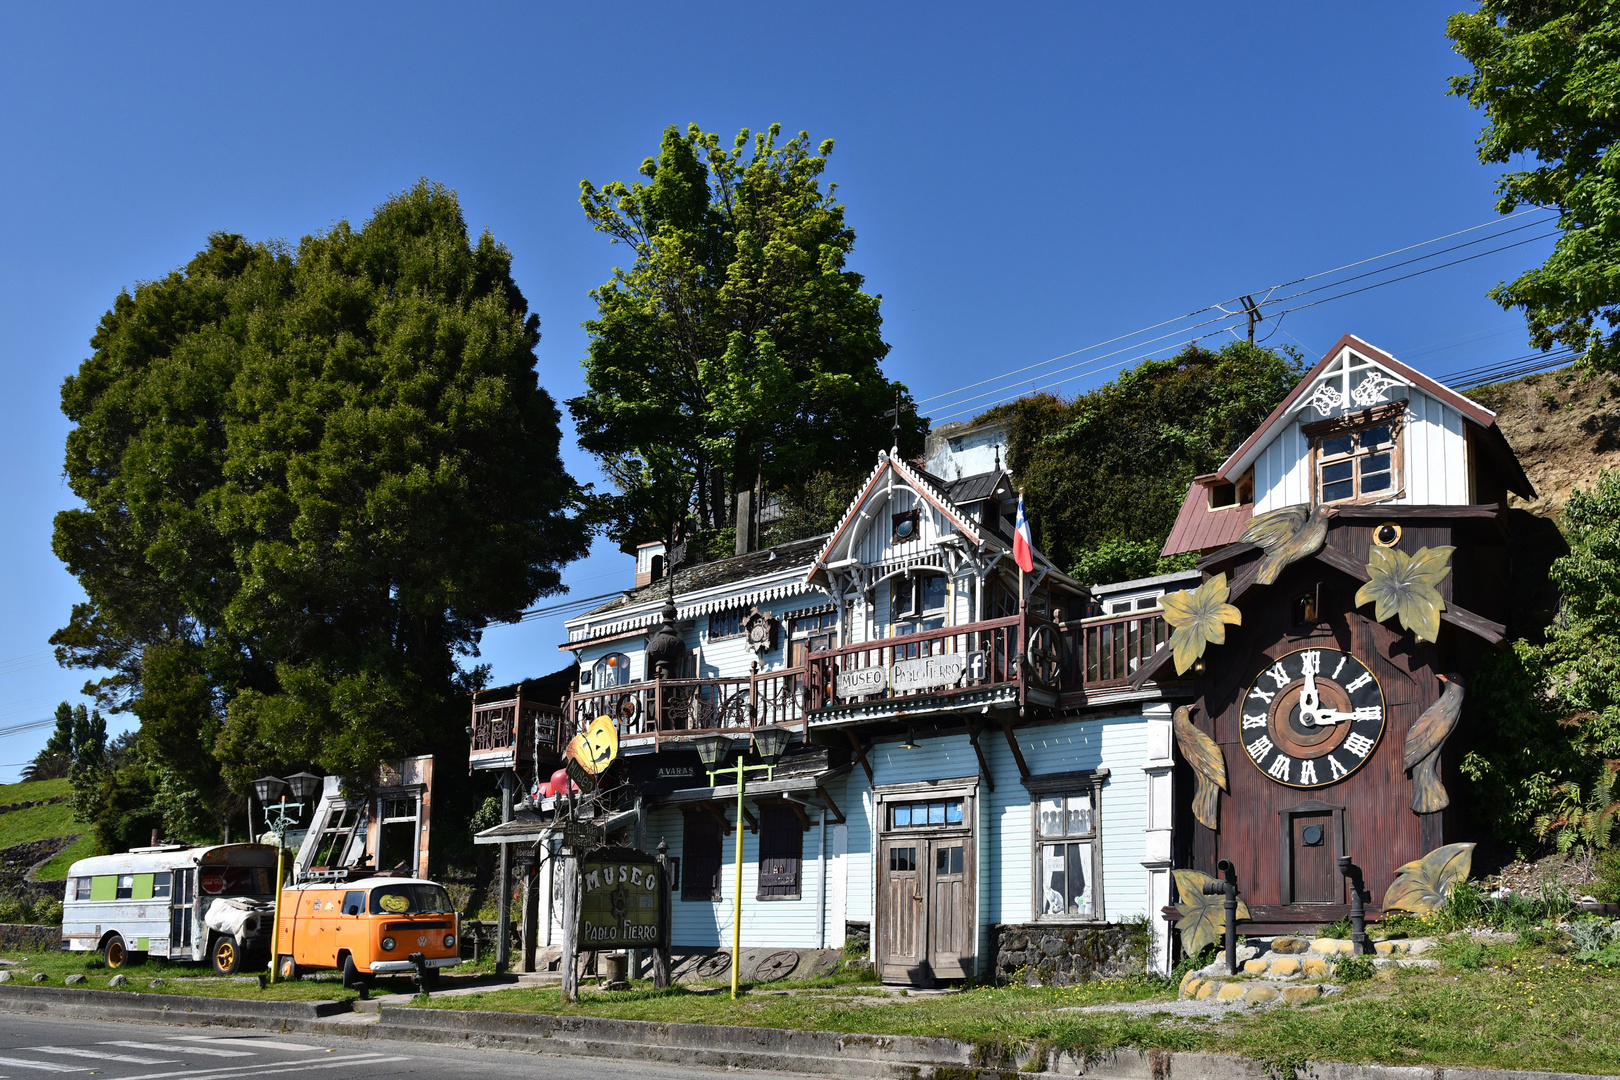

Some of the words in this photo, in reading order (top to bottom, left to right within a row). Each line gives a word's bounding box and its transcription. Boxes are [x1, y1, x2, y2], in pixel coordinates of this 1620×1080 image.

[842, 670, 881, 688] MUSEO
[1266, 662, 1291, 688] XI
[1332, 656, 1346, 679] I
[1345, 672, 1372, 693] II
[1249, 687, 1275, 704] X
[1242, 713, 1267, 730] IX
[1246, 735, 1273, 763] VIII
[1268, 754, 1291, 782] VII
[1300, 760, 1318, 785] VI
[1328, 754, 1348, 780] V
[585, 865, 656, 892] MUSEO
[584, 921, 617, 940] PABLO
[623, 919, 657, 940] FIERRO
